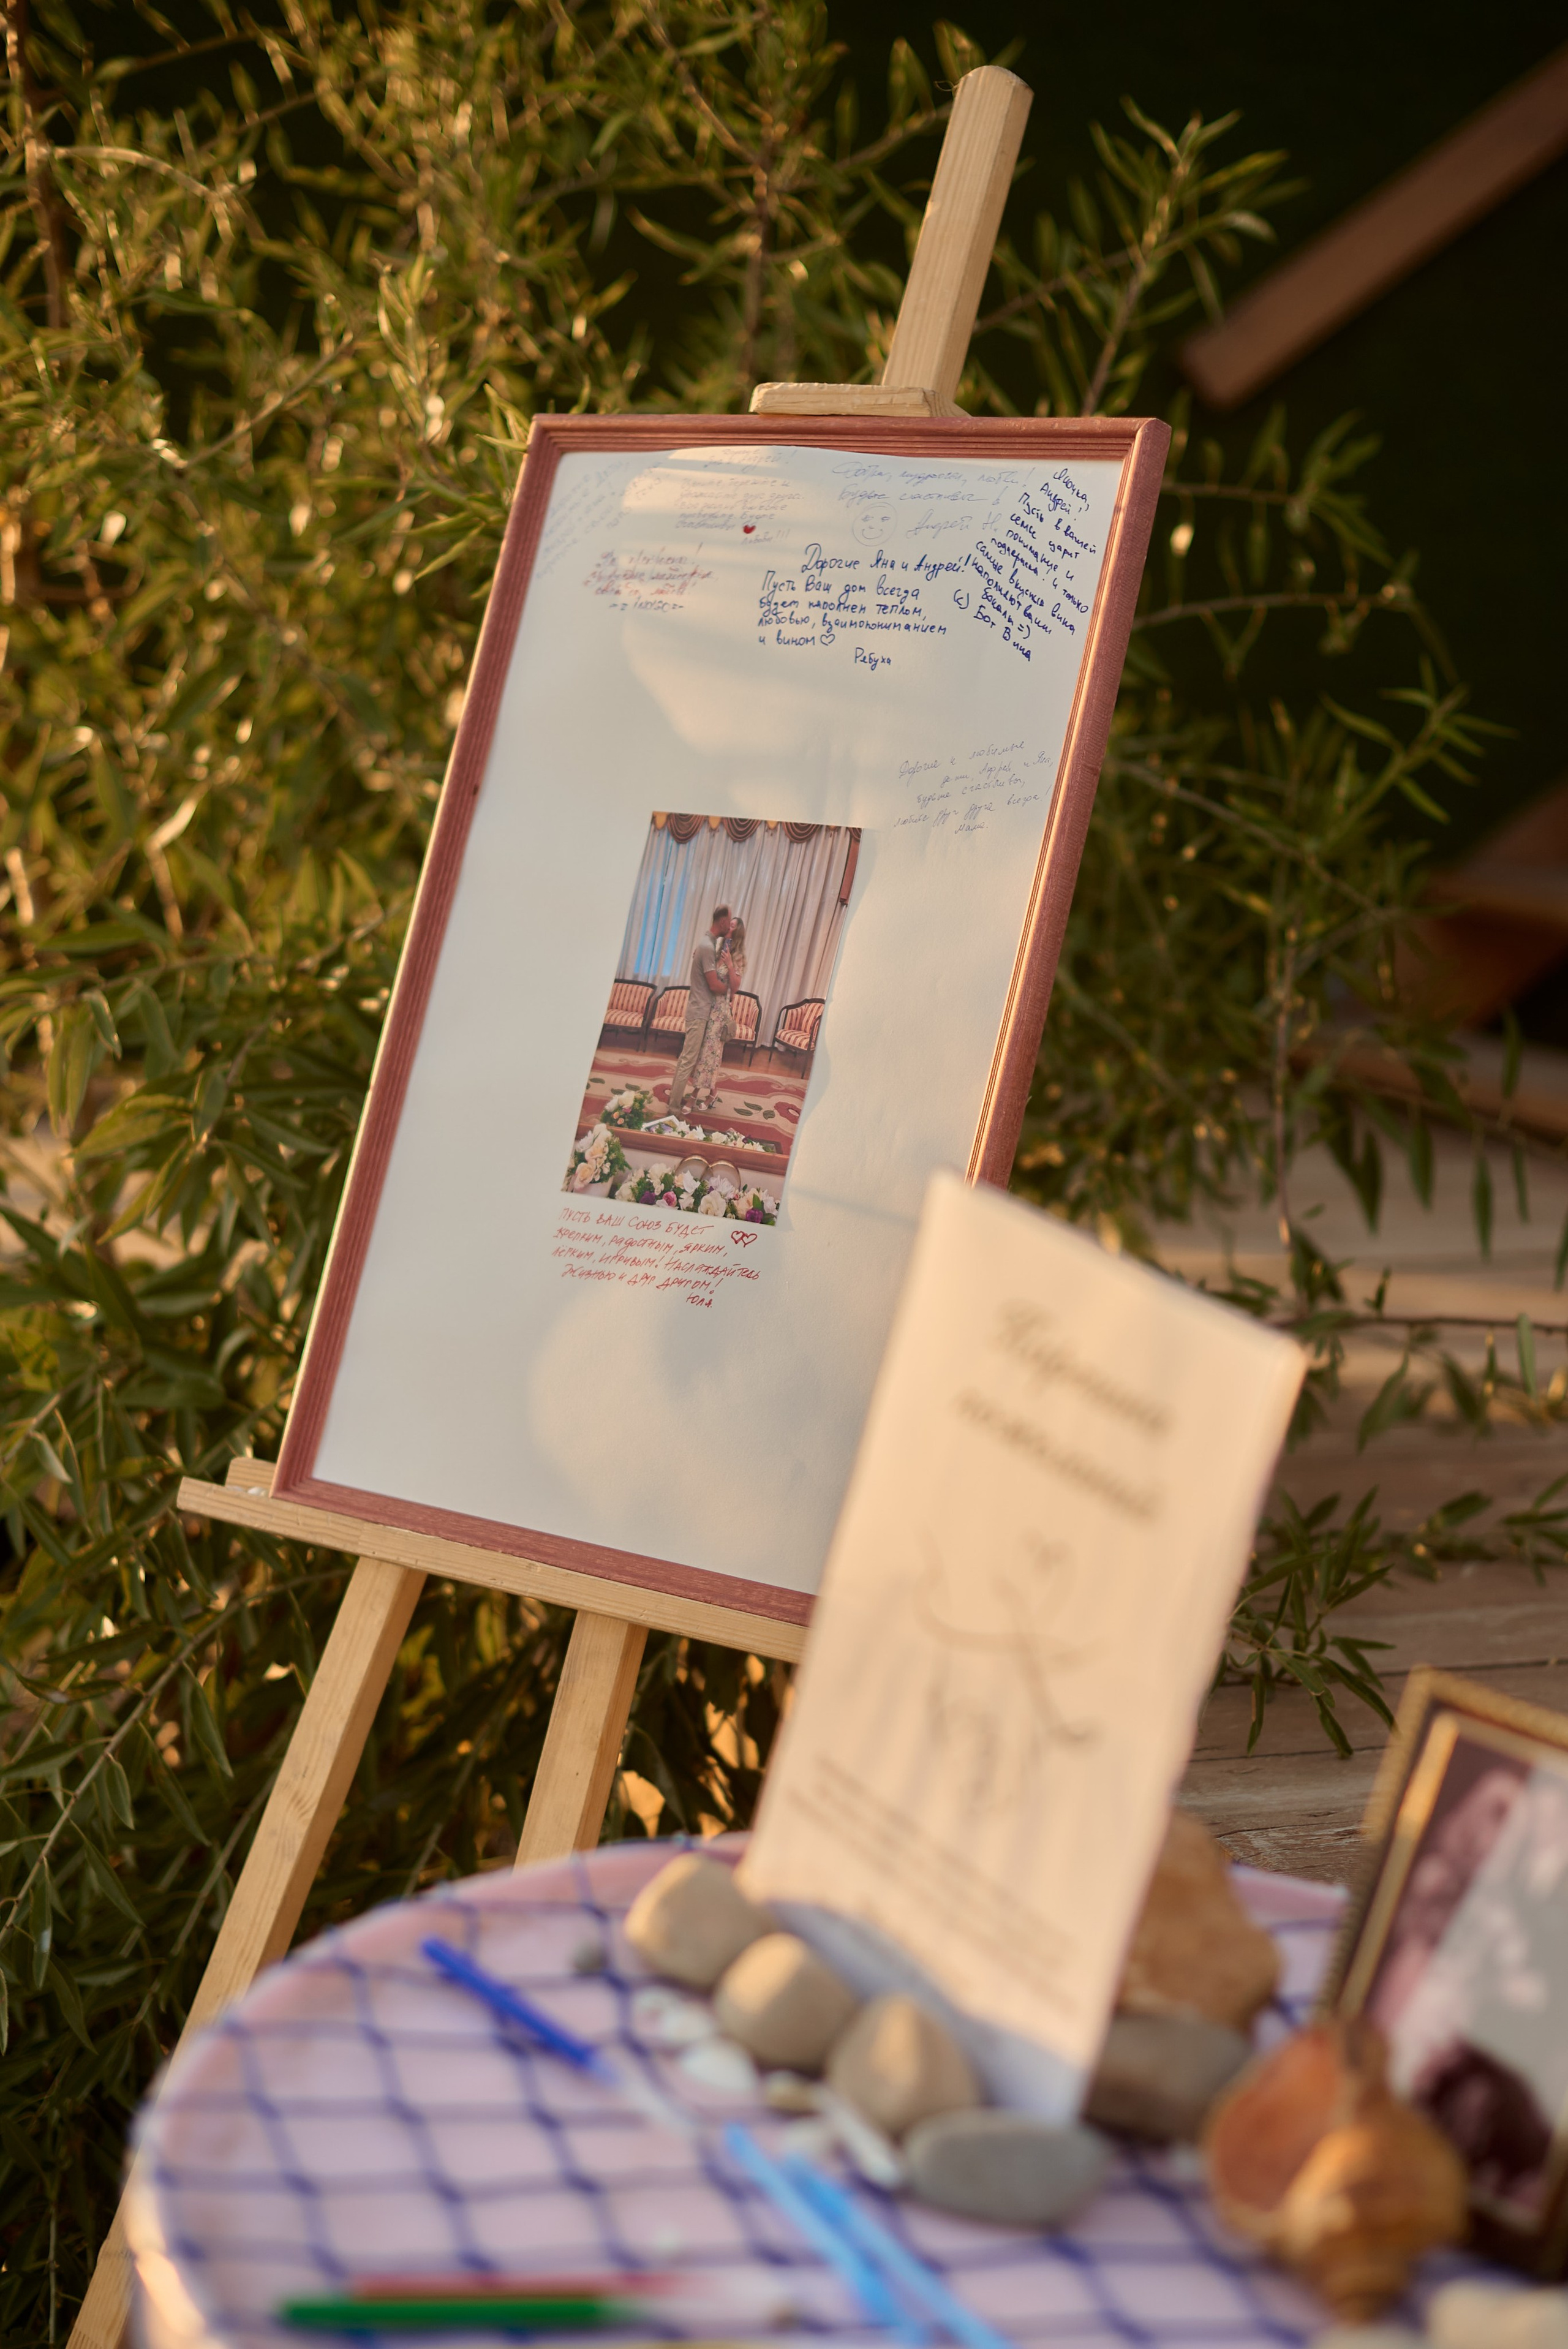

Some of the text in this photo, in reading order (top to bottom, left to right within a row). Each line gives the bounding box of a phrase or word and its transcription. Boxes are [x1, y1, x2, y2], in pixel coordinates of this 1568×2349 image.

[1018, 492, 1044, 523] Пусть
[801, 543, 972, 581] Дорогие Яна и Андрей!
[762, 570, 796, 601] Пусть
[837, 583, 866, 604] дом
[876, 574, 920, 605] всегда
[757, 611, 816, 630] любовью,
[759, 597, 799, 617] будет
[875, 603, 927, 621] теплом,
[758, 629, 816, 646] и вином
